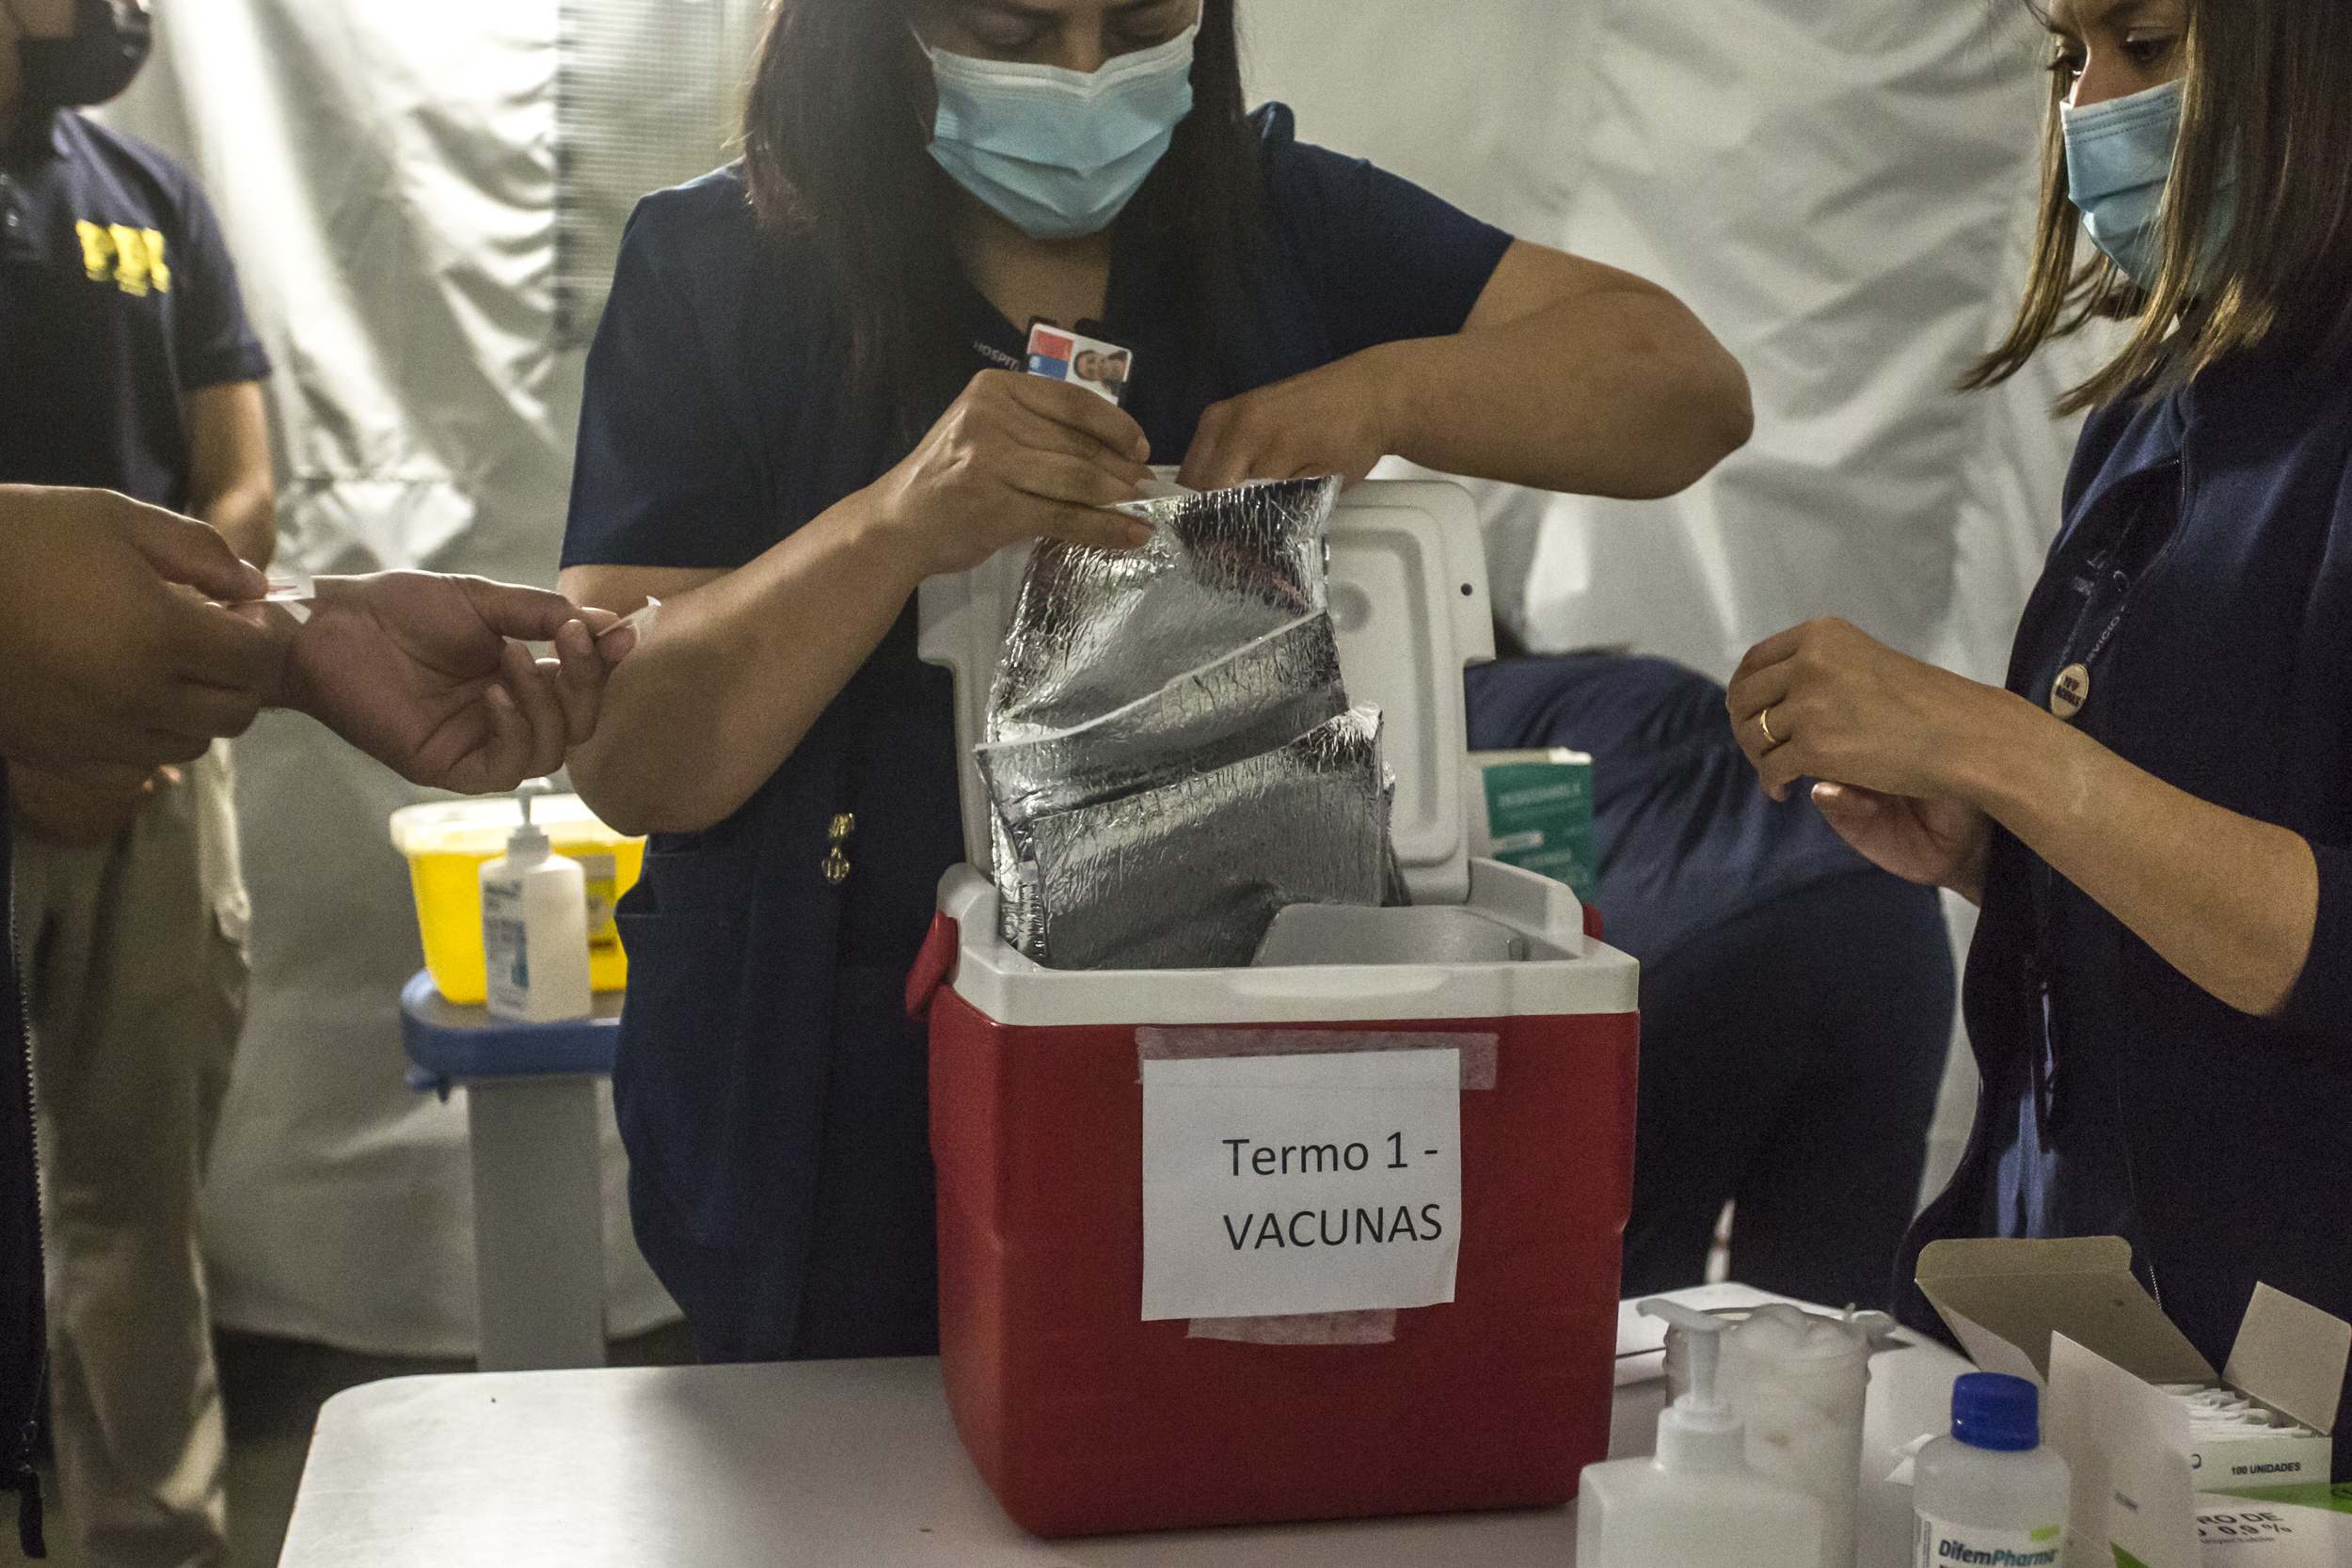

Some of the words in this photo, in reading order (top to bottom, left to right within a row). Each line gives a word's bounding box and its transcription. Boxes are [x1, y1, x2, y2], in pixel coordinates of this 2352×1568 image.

[1222, 1138, 1369, 1177] Termo
[1387, 1132, 1407, 1168] 1
[1223, 1204, 1442, 1250] VACUNAS
[2232, 1466, 2248, 1475] 100
[2249, 1462, 2301, 1474] UNIDADES
[2240, 1513, 2283, 1522] DE
